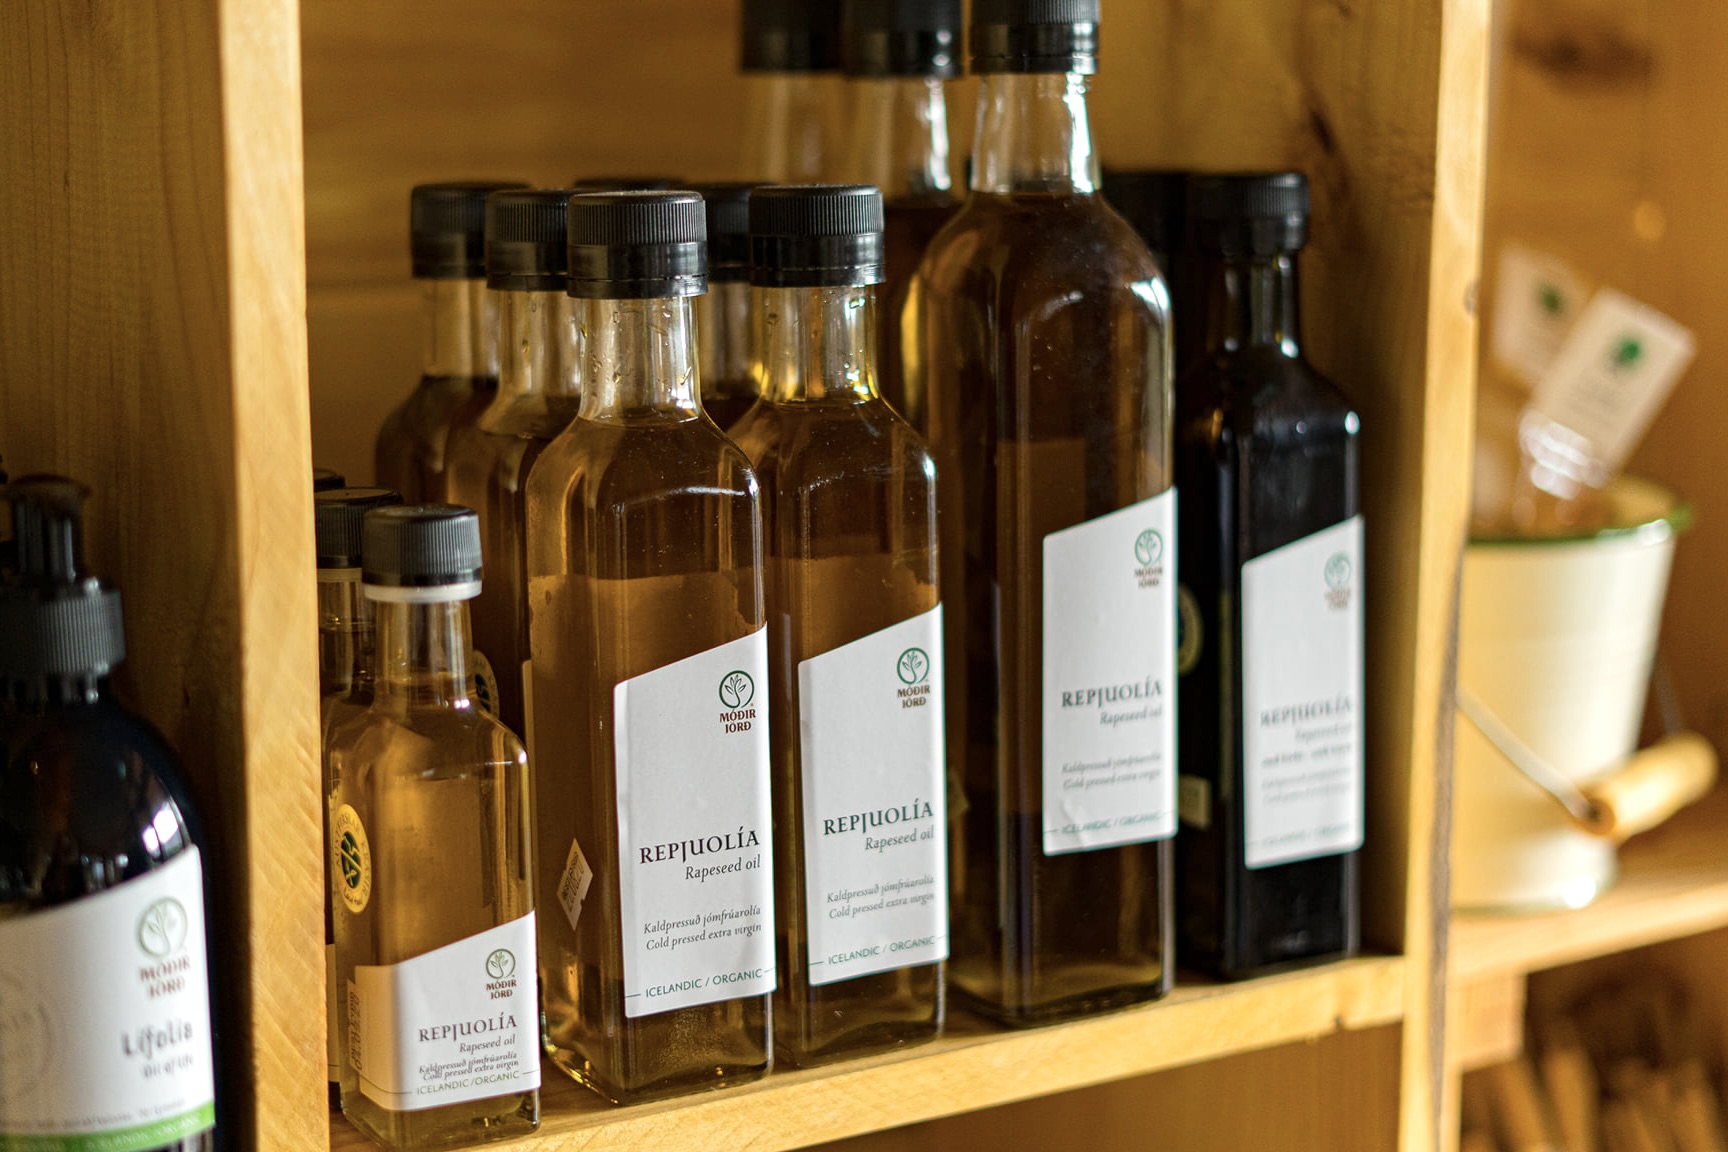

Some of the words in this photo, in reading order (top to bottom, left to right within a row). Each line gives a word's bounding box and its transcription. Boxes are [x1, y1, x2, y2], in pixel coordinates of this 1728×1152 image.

[1062, 675, 1162, 708] REPJUOLÍA
[823, 798, 934, 836] REPJUOLÍA
[639, 826, 760, 864] REPJUOLÍA
[865, 829, 917, 852] Rapeseed
[920, 824, 934, 840] oil
[685, 857, 742, 882] Rapeseed
[745, 854, 761, 870] oil
[644, 914, 701, 935] Kaldpressuð
[703, 905, 761, 926] jómfrúarolía
[829, 905, 850, 919] Cold
[852, 900, 884, 918] pressed
[886, 897, 907, 907] extra
[646, 936, 669, 951] Cold
[671, 931, 706, 950] pressed
[708, 928, 732, 939] extra
[734, 924, 761, 937] virgin
[828, 946, 881, 965] ICELANDIC
[889, 935, 936, 953] ORGANIC
[645, 978, 702, 998] ICELANDIC
[712, 968, 763, 986] ORGANIC
[418, 1012, 518, 1042] REPJUOLÍA
[459, 1037, 501, 1055] Rapeseed
[504, 1034, 516, 1046] oil
[444, 1066, 472, 1080] pressed
[475, 1064, 494, 1073] extra
[496, 1060, 519, 1071] virgin
